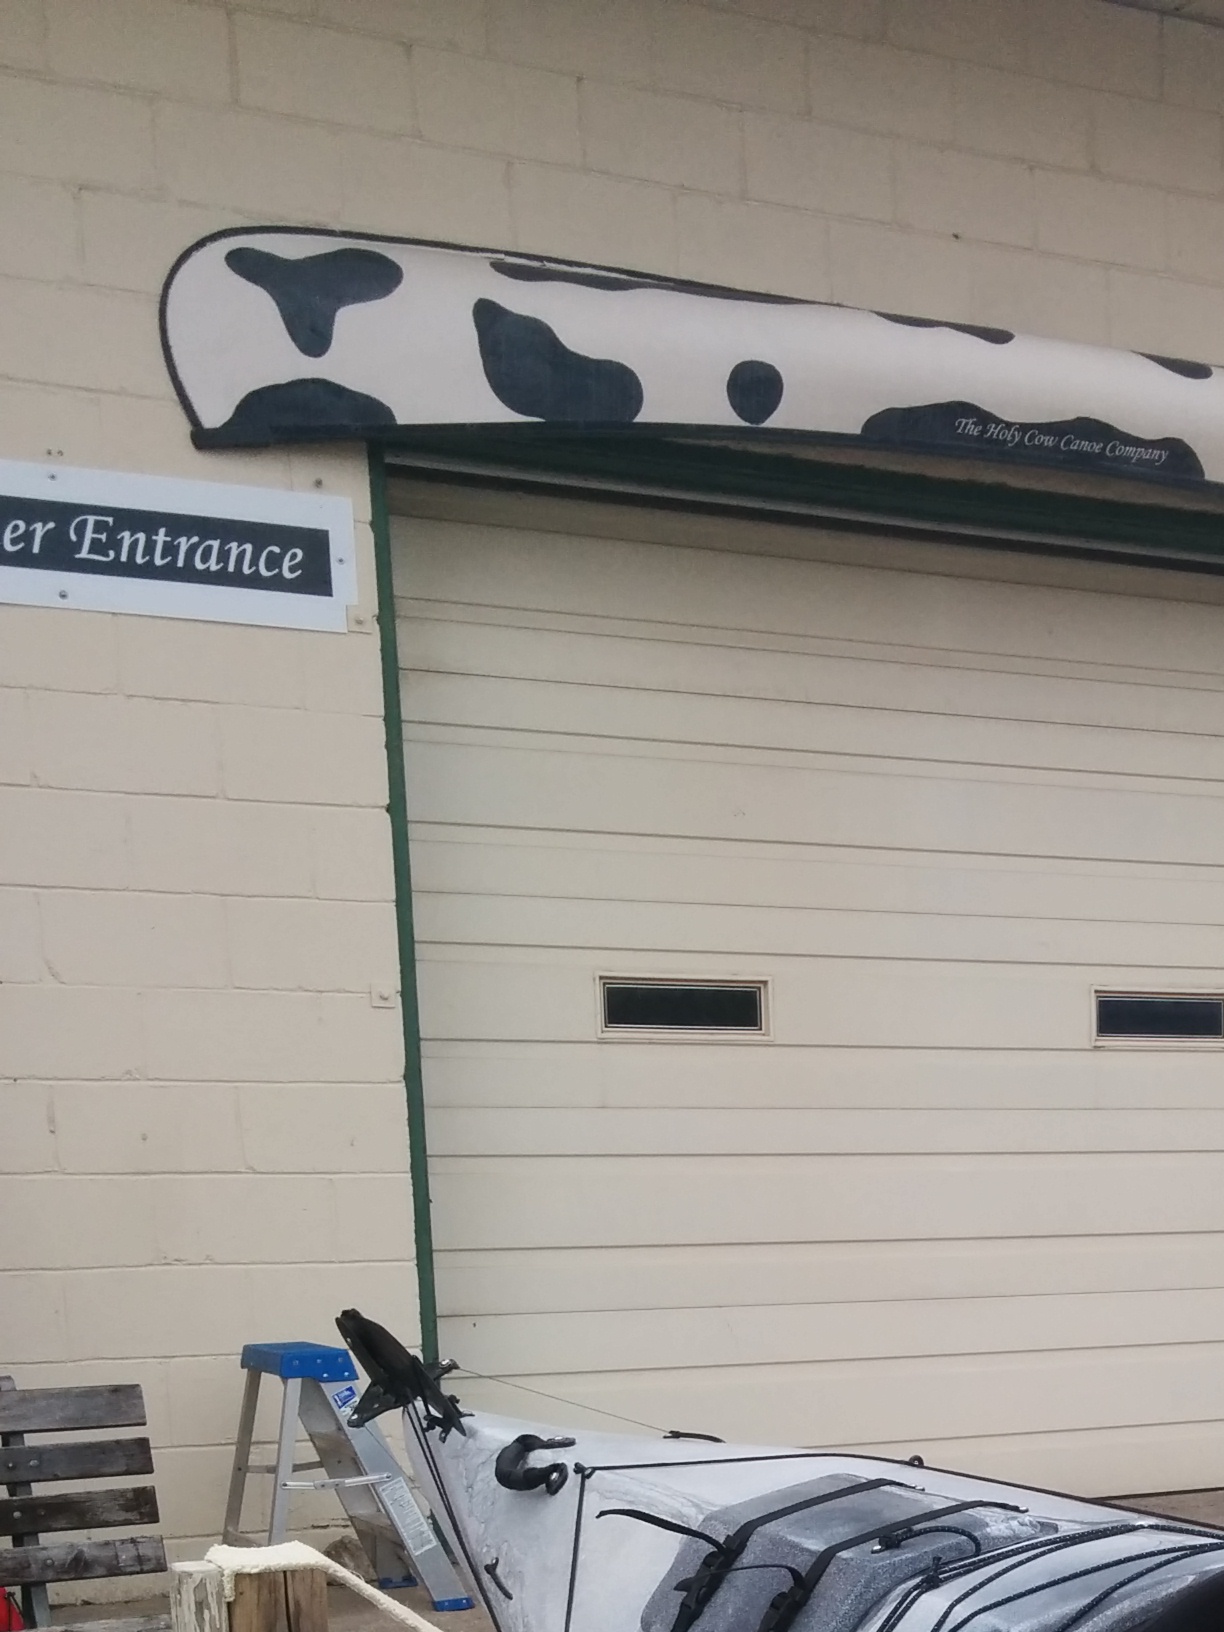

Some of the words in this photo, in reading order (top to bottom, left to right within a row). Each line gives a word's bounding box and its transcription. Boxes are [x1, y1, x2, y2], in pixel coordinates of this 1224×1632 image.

[955, 418, 982, 436] The
[984, 423, 1022, 447] Holy
[1024, 430, 1058, 446] Cow
[1061, 434, 1103, 454] Canoe
[1106, 441, 1169, 466] Company
[69, 515, 304, 579] Entrance
